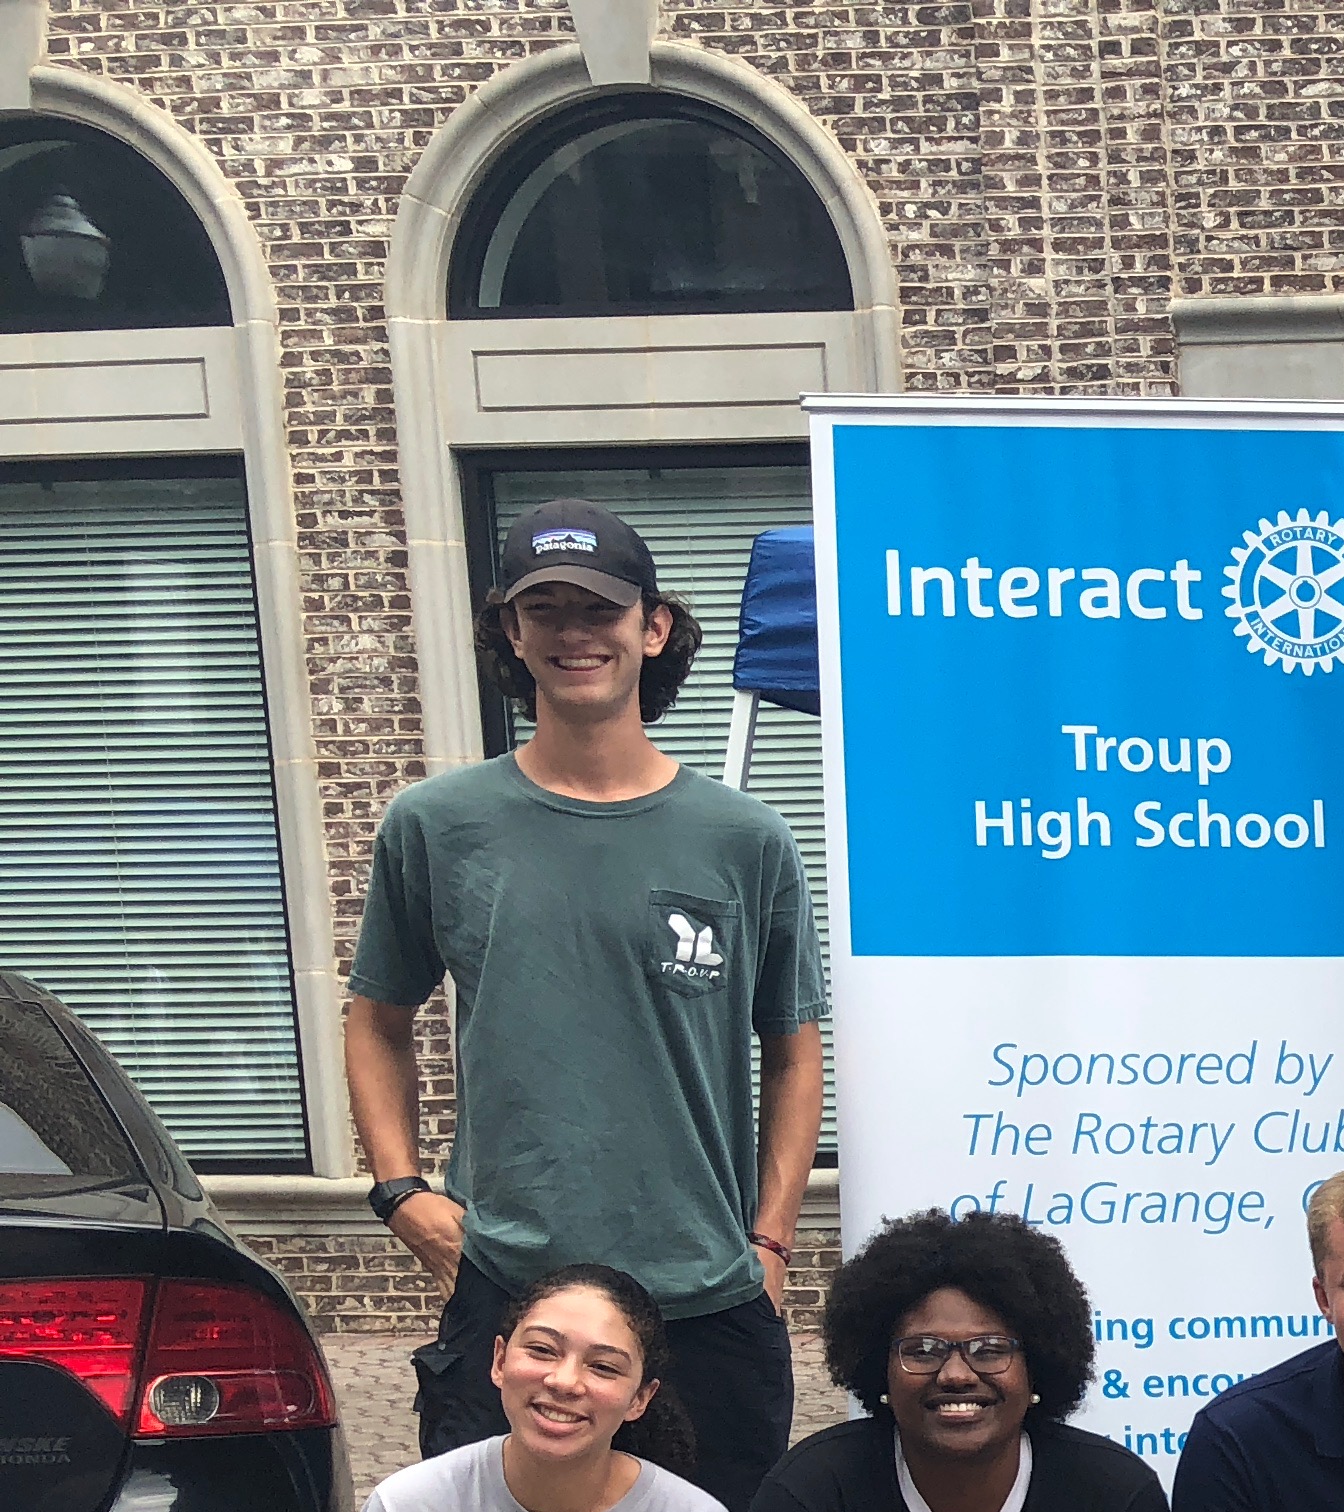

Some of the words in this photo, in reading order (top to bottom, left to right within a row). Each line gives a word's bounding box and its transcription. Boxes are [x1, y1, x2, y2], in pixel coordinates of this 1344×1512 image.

[536, 541, 595, 555] patagonia
[1269, 527, 1338, 547] ROTARY
[886, 549, 1203, 621] Interact
[1062, 725, 1232, 786] Troup
[975, 798, 1111, 860] High
[1134, 799, 1325, 849] School
[988, 1039, 1258, 1098] Sponsored
[1274, 1039, 1334, 1096] by
[963, 1111, 1053, 1156] The
[1071, 1112, 1236, 1166] Rotary
[1024, 1181, 1275, 1236] LaGrange,
[1168, 1313, 1335, 1340] commun
[1102, 1368, 1131, 1399] &
